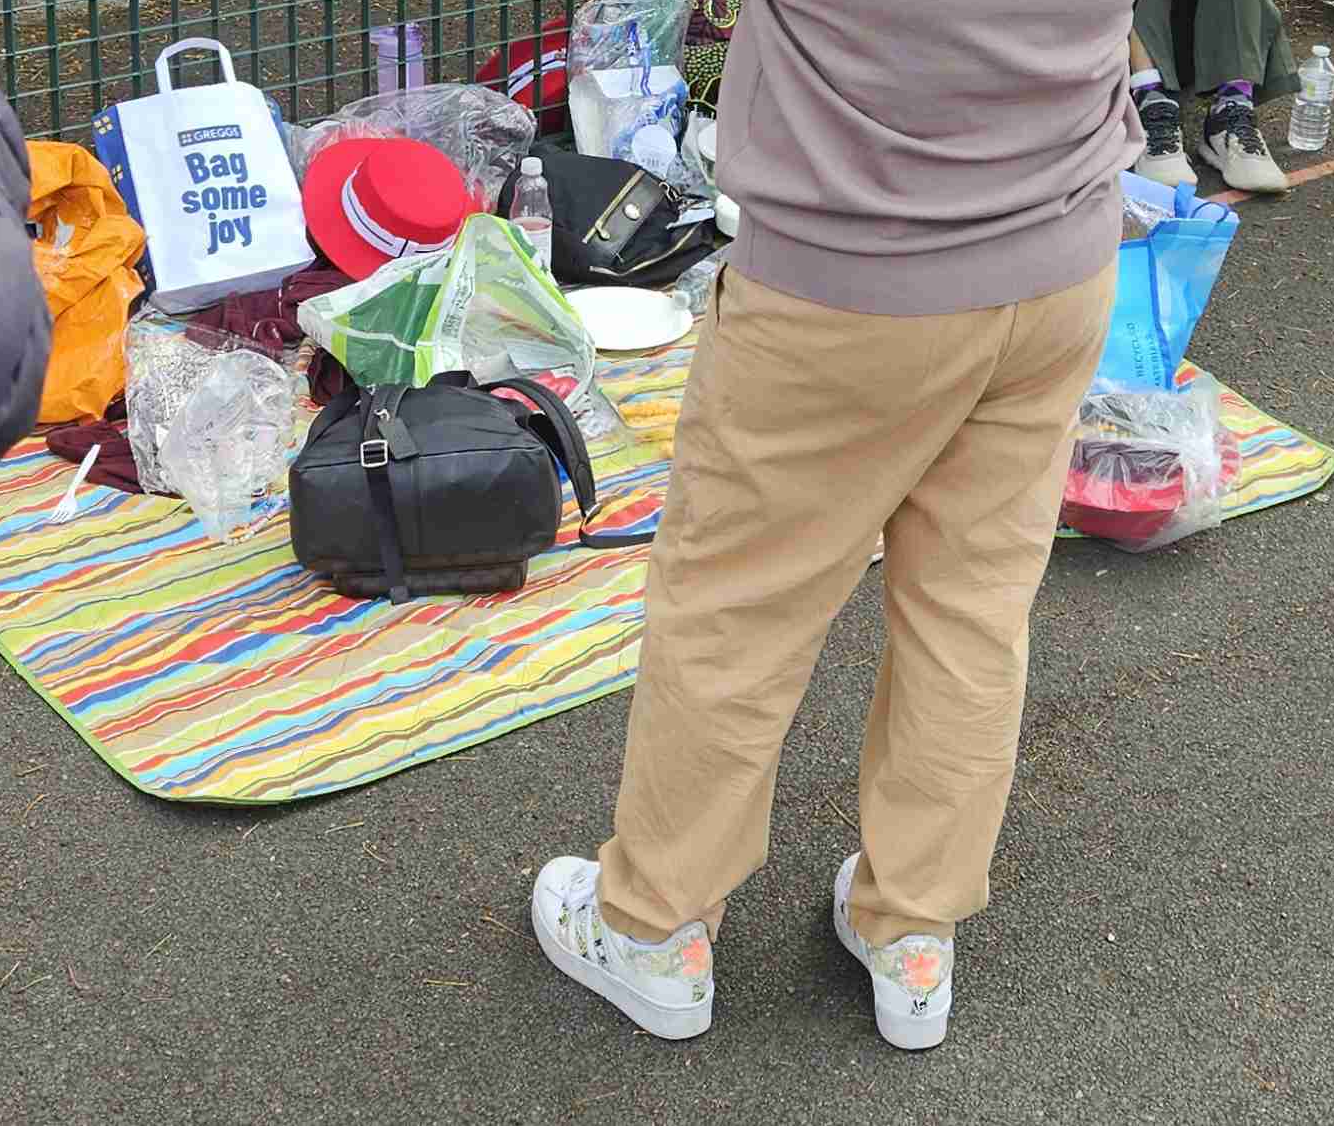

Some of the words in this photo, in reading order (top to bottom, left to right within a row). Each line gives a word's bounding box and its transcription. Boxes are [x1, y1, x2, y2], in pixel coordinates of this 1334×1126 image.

[193, 126, 240, 142] GREGGS
[185, 152, 248, 184] Bag
[181, 184, 267, 213] some
[207, 212, 252, 255] joy
